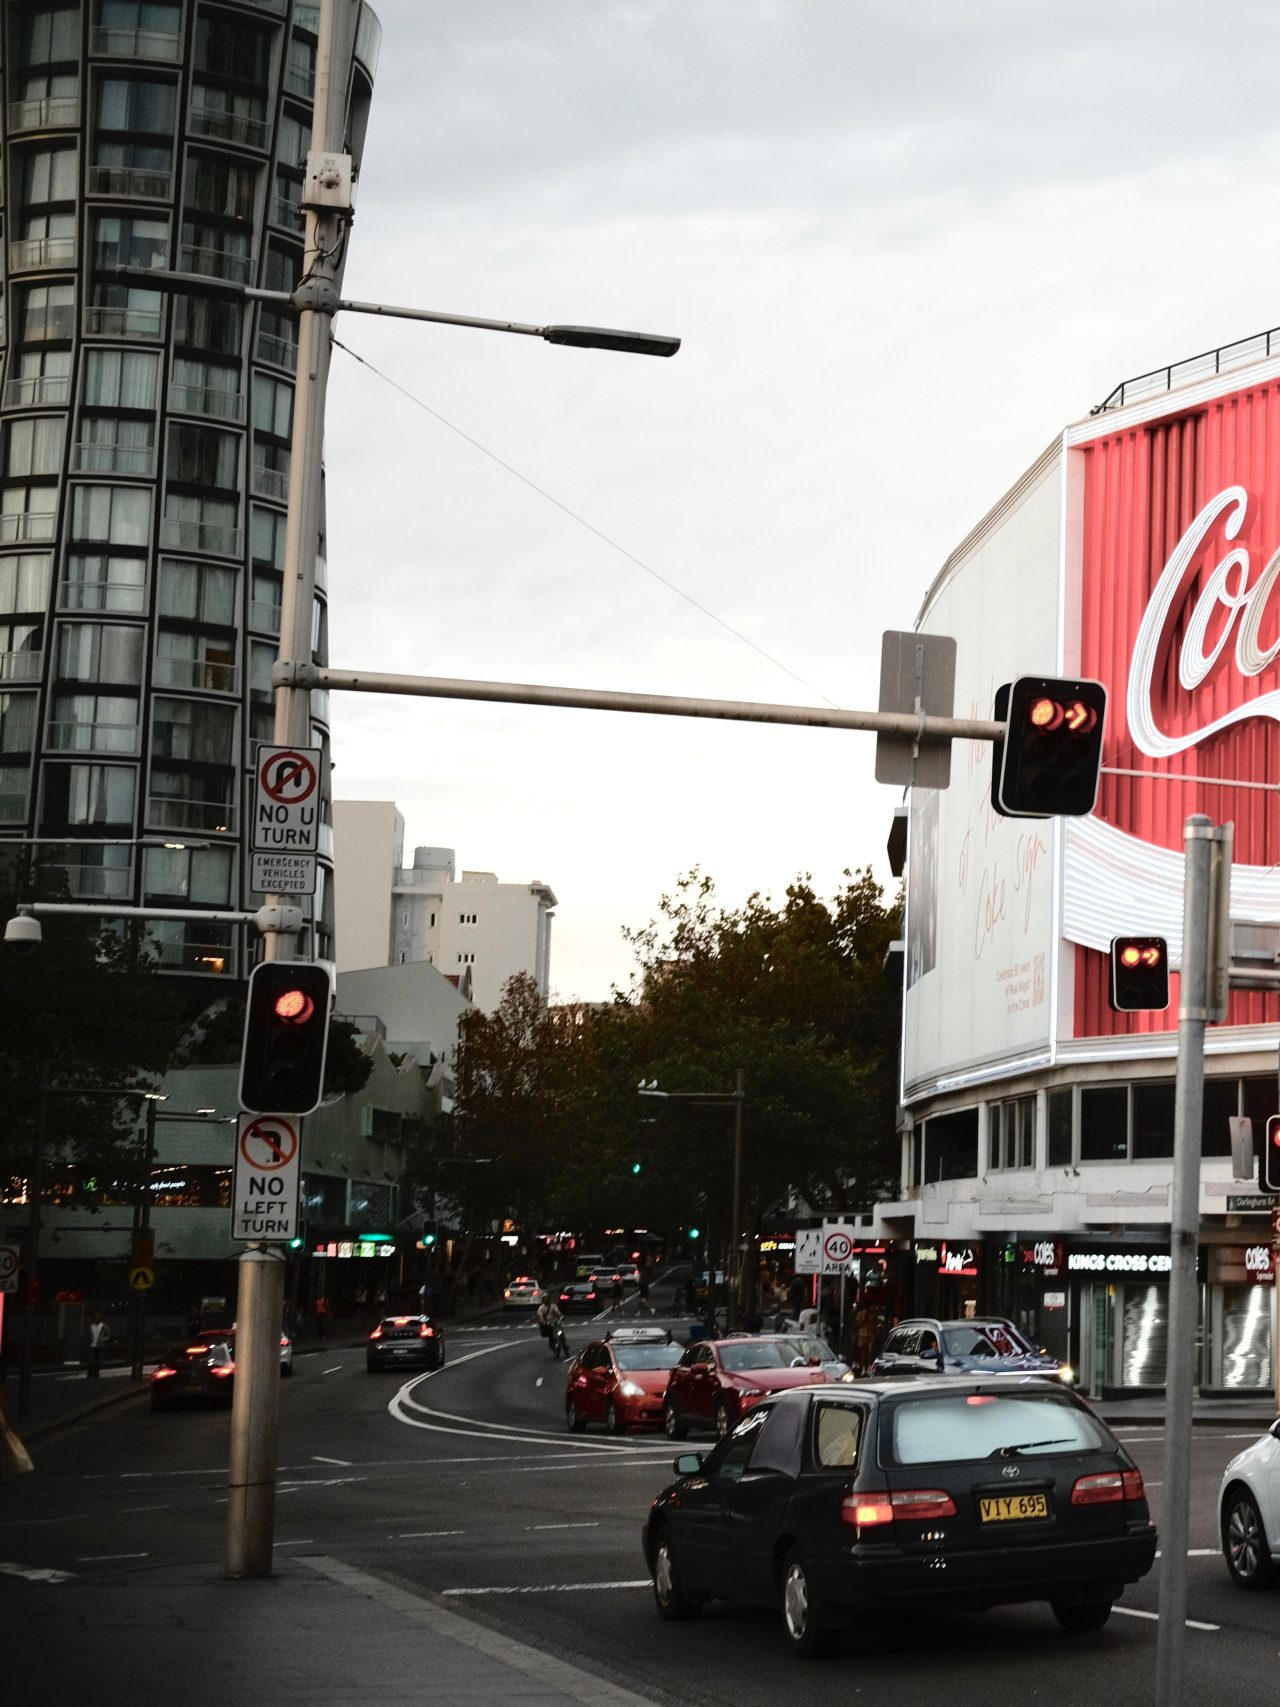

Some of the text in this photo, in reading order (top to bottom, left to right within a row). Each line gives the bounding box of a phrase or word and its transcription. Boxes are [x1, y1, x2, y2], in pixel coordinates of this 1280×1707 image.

[259, 804, 315, 825] NO U
[261, 827, 311, 845] TURN
[257, 857, 311, 868] EMERGENCY
[263, 869, 306, 879] VEHICLES
[261, 879, 306, 890] EXCEPTED
[250, 1177, 284, 1196] NO
[243, 1201, 287, 1215] LEFT
[241, 1220, 289, 1233] TURN
[829, 1241, 848, 1254] 40
[1068, 1254, 1105, 1271] KINGS
[1106, 1254, 1147, 1271] CROSS
[1245, 1245, 1270, 1270] coles
[982, 1496, 1045, 1517] VIY 695
